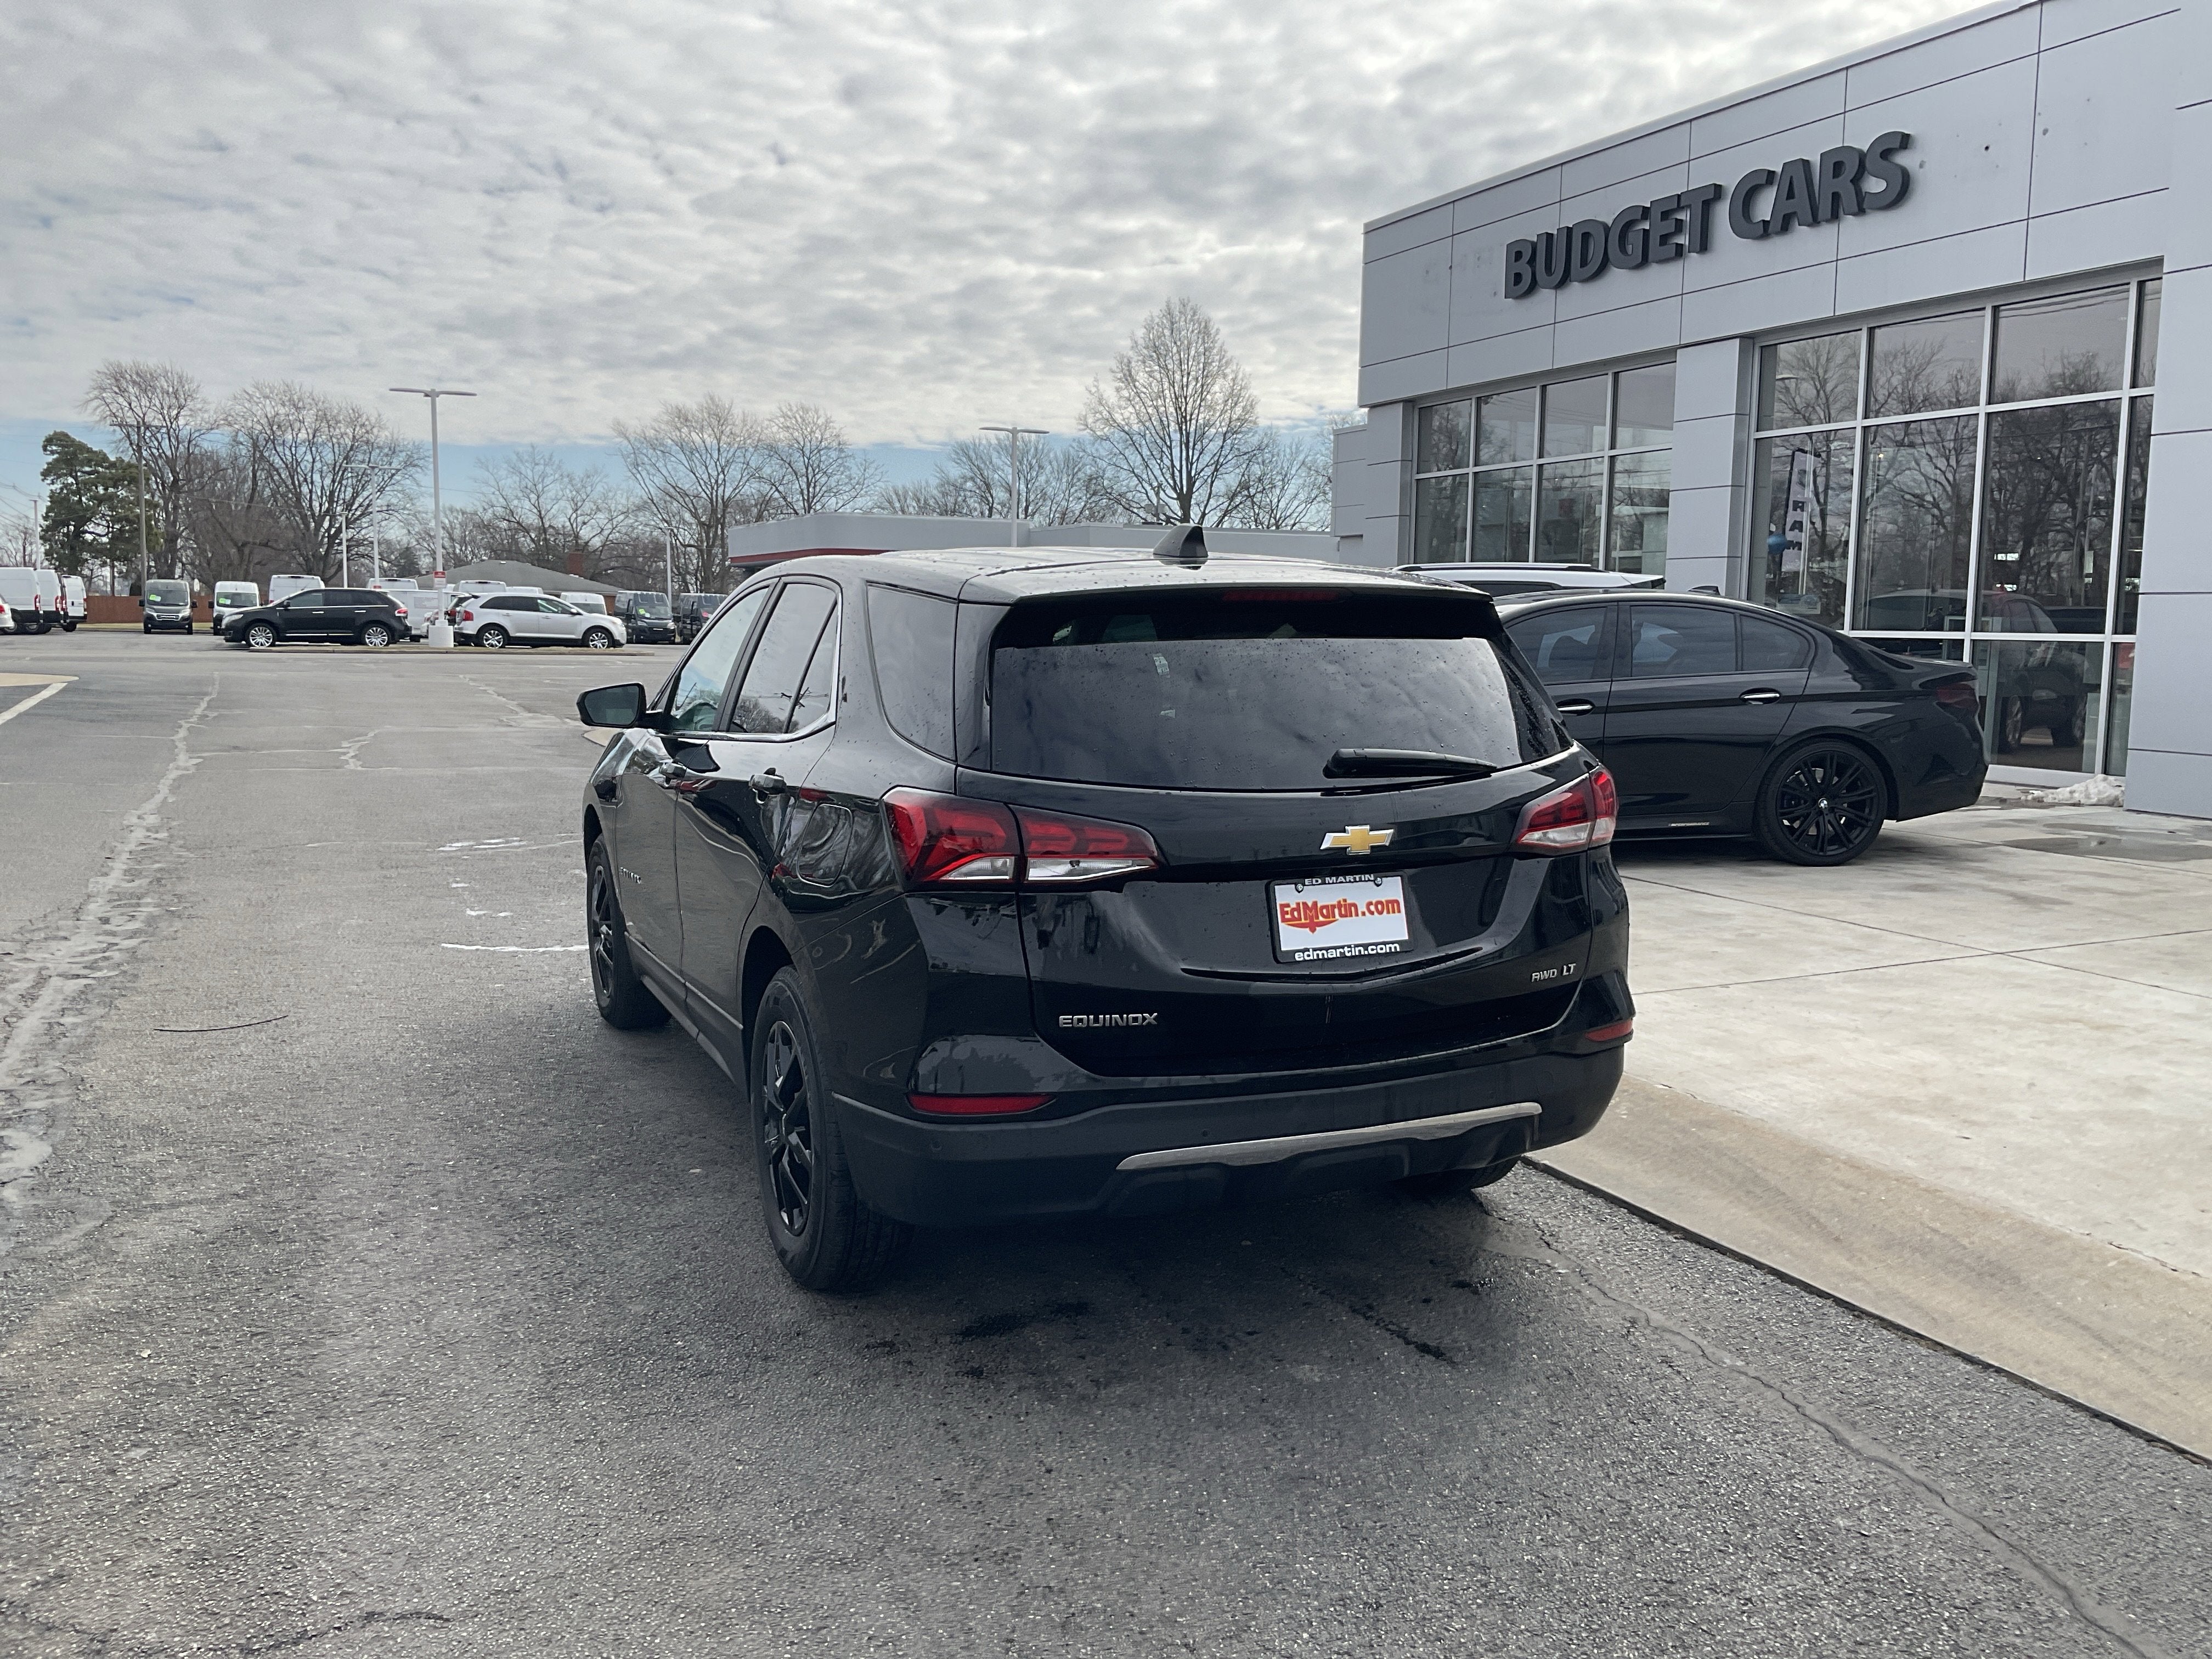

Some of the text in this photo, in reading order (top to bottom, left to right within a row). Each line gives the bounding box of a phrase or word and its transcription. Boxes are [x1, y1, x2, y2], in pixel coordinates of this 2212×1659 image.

[1504, 131, 1911, 299] BUDGET CARS
[1325, 874, 1374, 884] MARTIN
[1279, 898, 1401, 926] EdMartin.com
[1295, 943, 1400, 961] edmartin.com
[1532, 963, 1576, 982] AWD LT
[1058, 1012, 1158, 1028] EQUINOX
